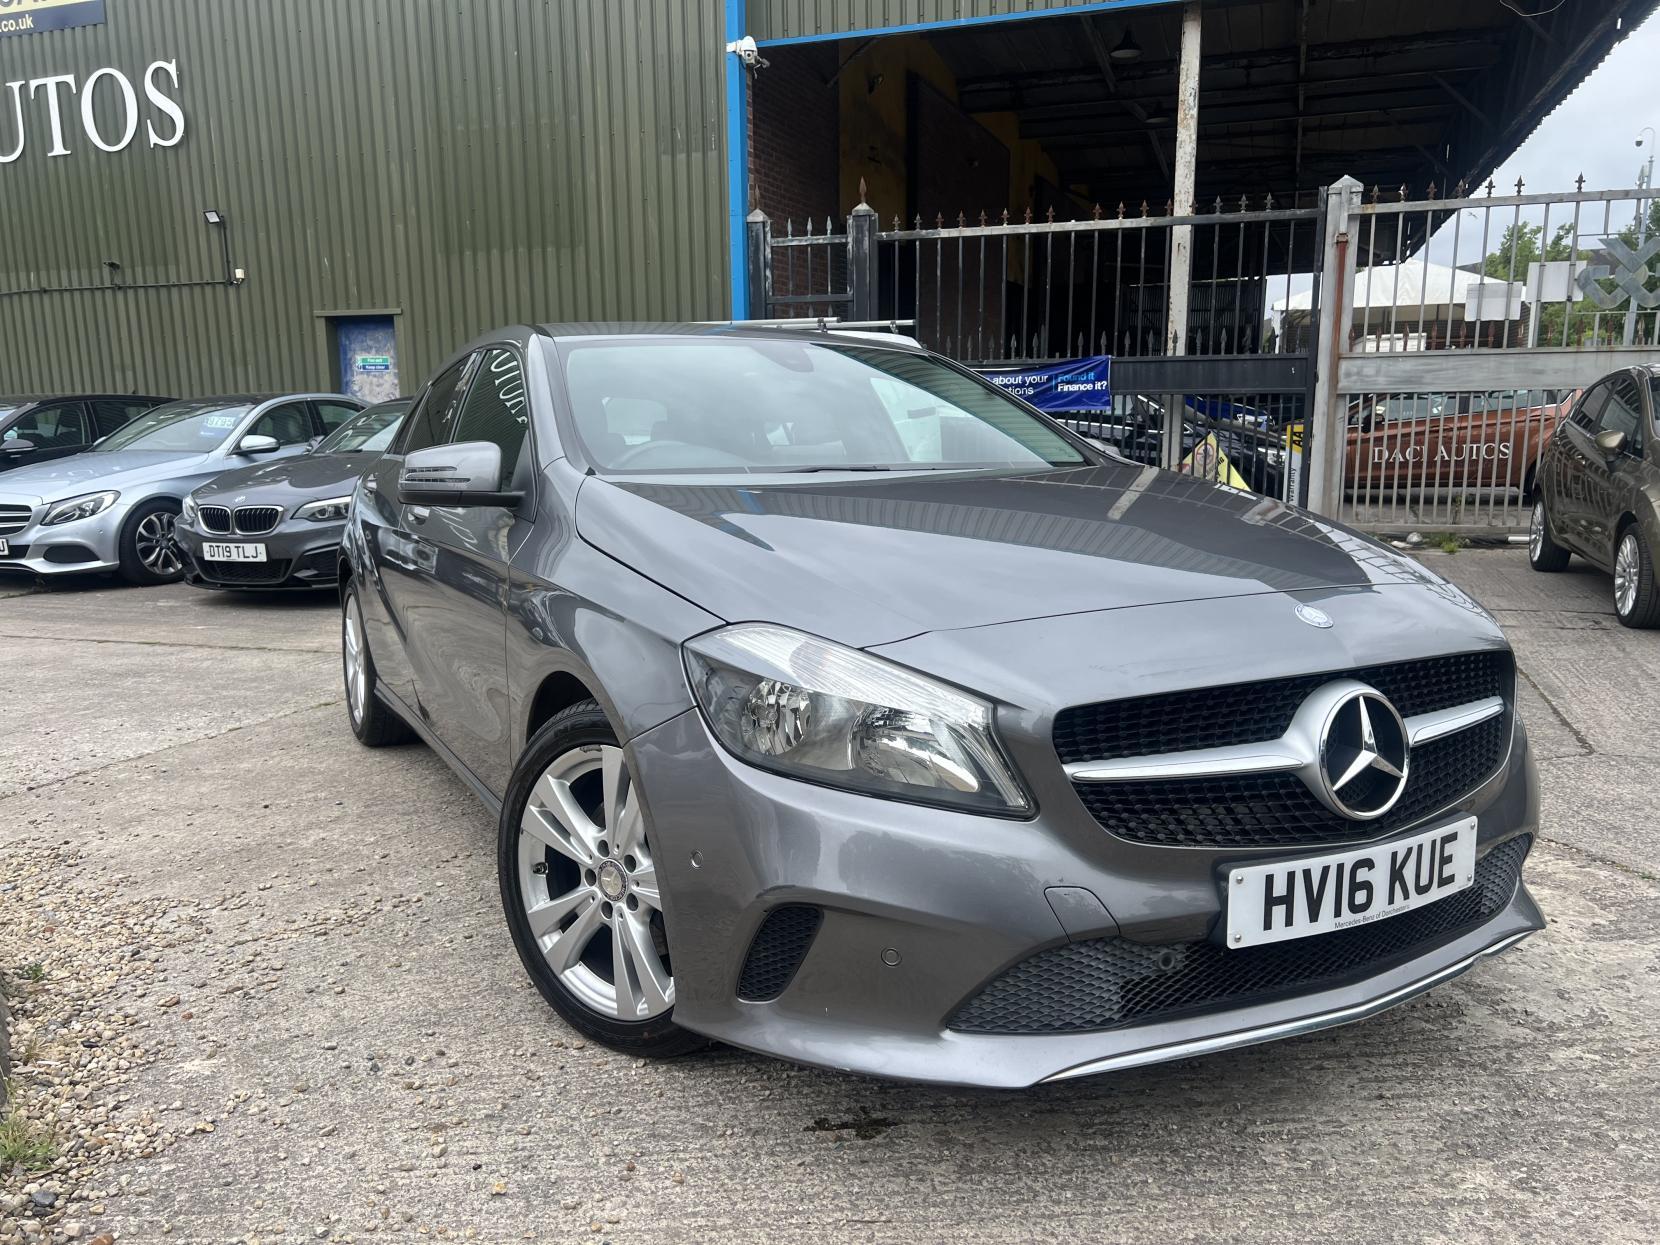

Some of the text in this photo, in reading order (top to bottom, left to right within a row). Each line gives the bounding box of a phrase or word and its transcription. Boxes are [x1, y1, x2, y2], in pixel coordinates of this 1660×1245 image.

[992, 375, 1049, 386] about your
[1057, 371, 1095, 382] Found it
[1006, 385, 1034, 395] tions
[1057, 380, 1108, 392] Finance it?
[208, 544, 258, 559] DT19 TLJ
[1263, 831, 1459, 932] HV16 KUE
